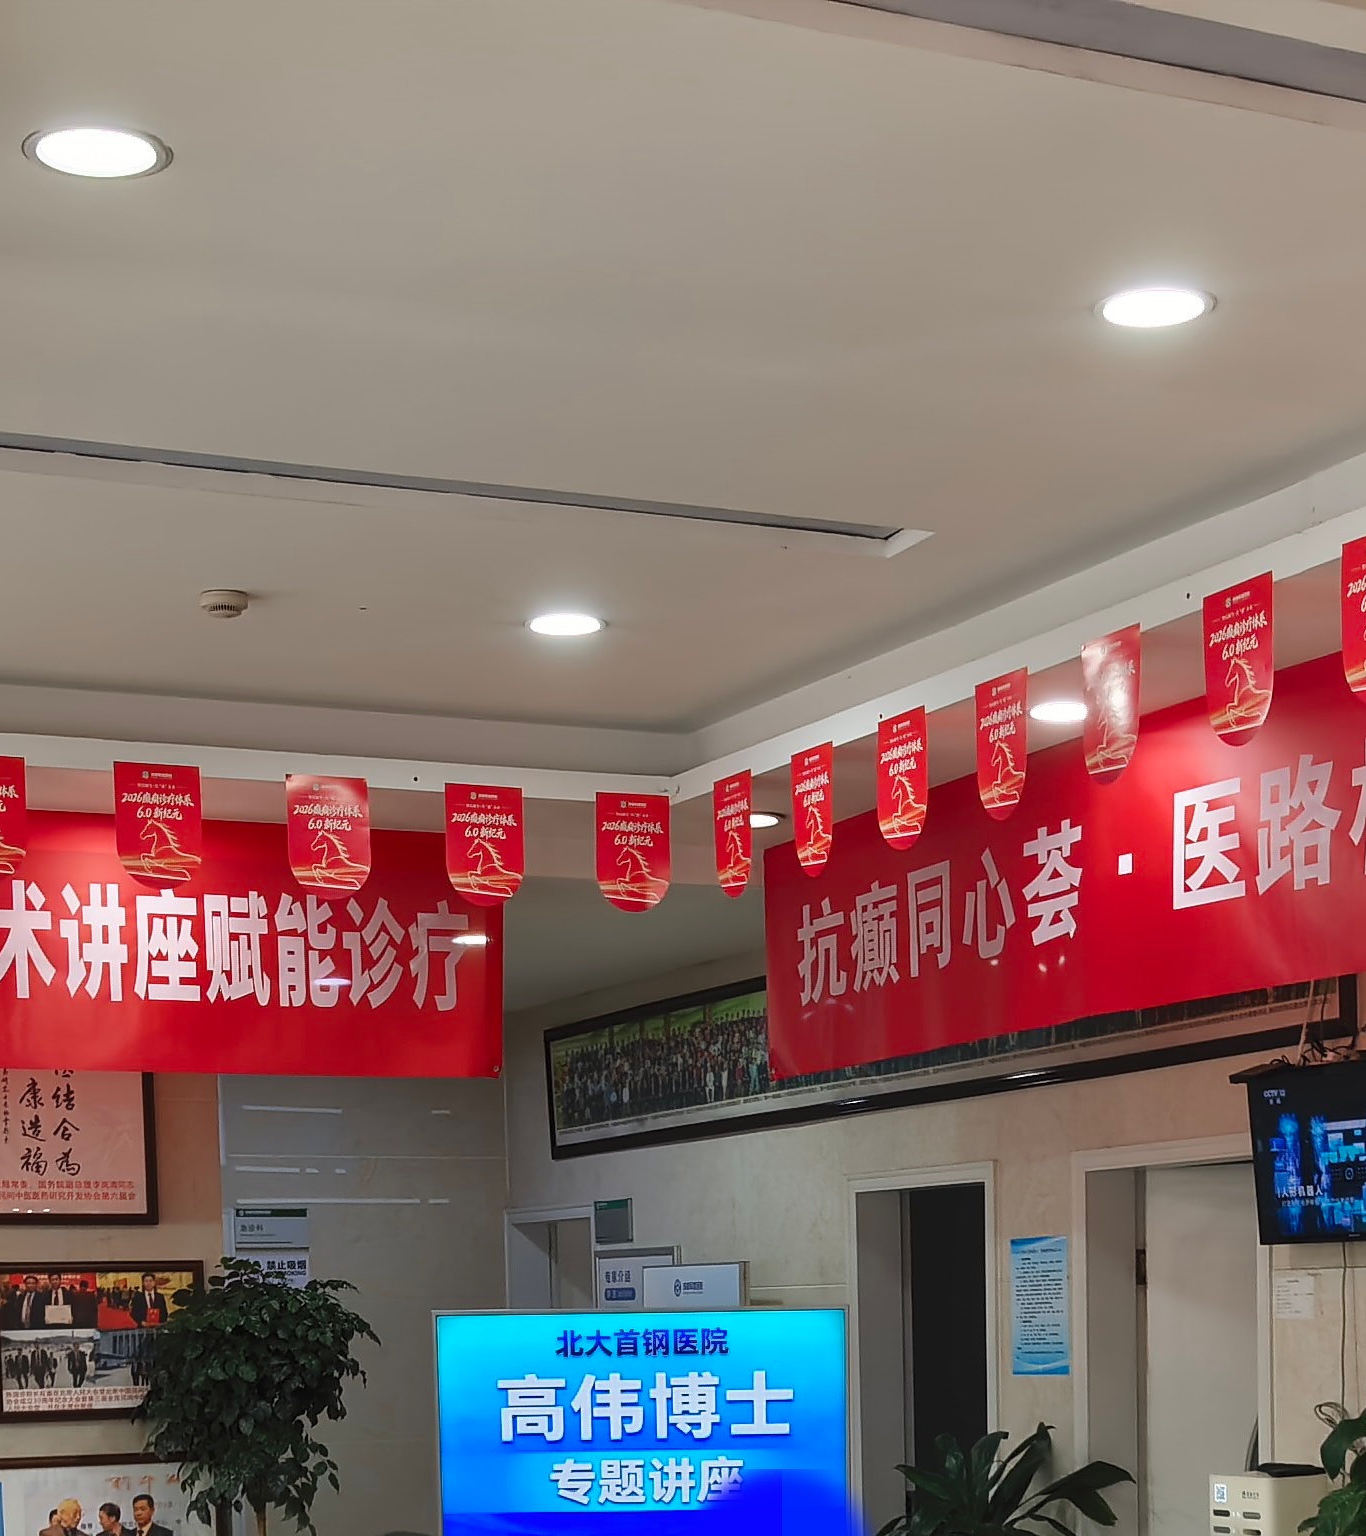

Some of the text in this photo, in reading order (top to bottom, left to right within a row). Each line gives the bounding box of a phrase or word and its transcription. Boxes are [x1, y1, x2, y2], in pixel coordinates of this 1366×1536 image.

[1222, 643, 1235, 661] 6.0
[136, 808, 183, 822] 6.0 新纪元
[308, 819, 323, 831] 6.0
[465, 826, 478, 838] 6.0
[267, 1259, 307, 1271] 禁止吸烟
[555, 1328, 730, 1358] 北大首钢医院
[497, 1369, 795, 1443] 高伟博士
[549, 1455, 745, 1505] 专题讲座
